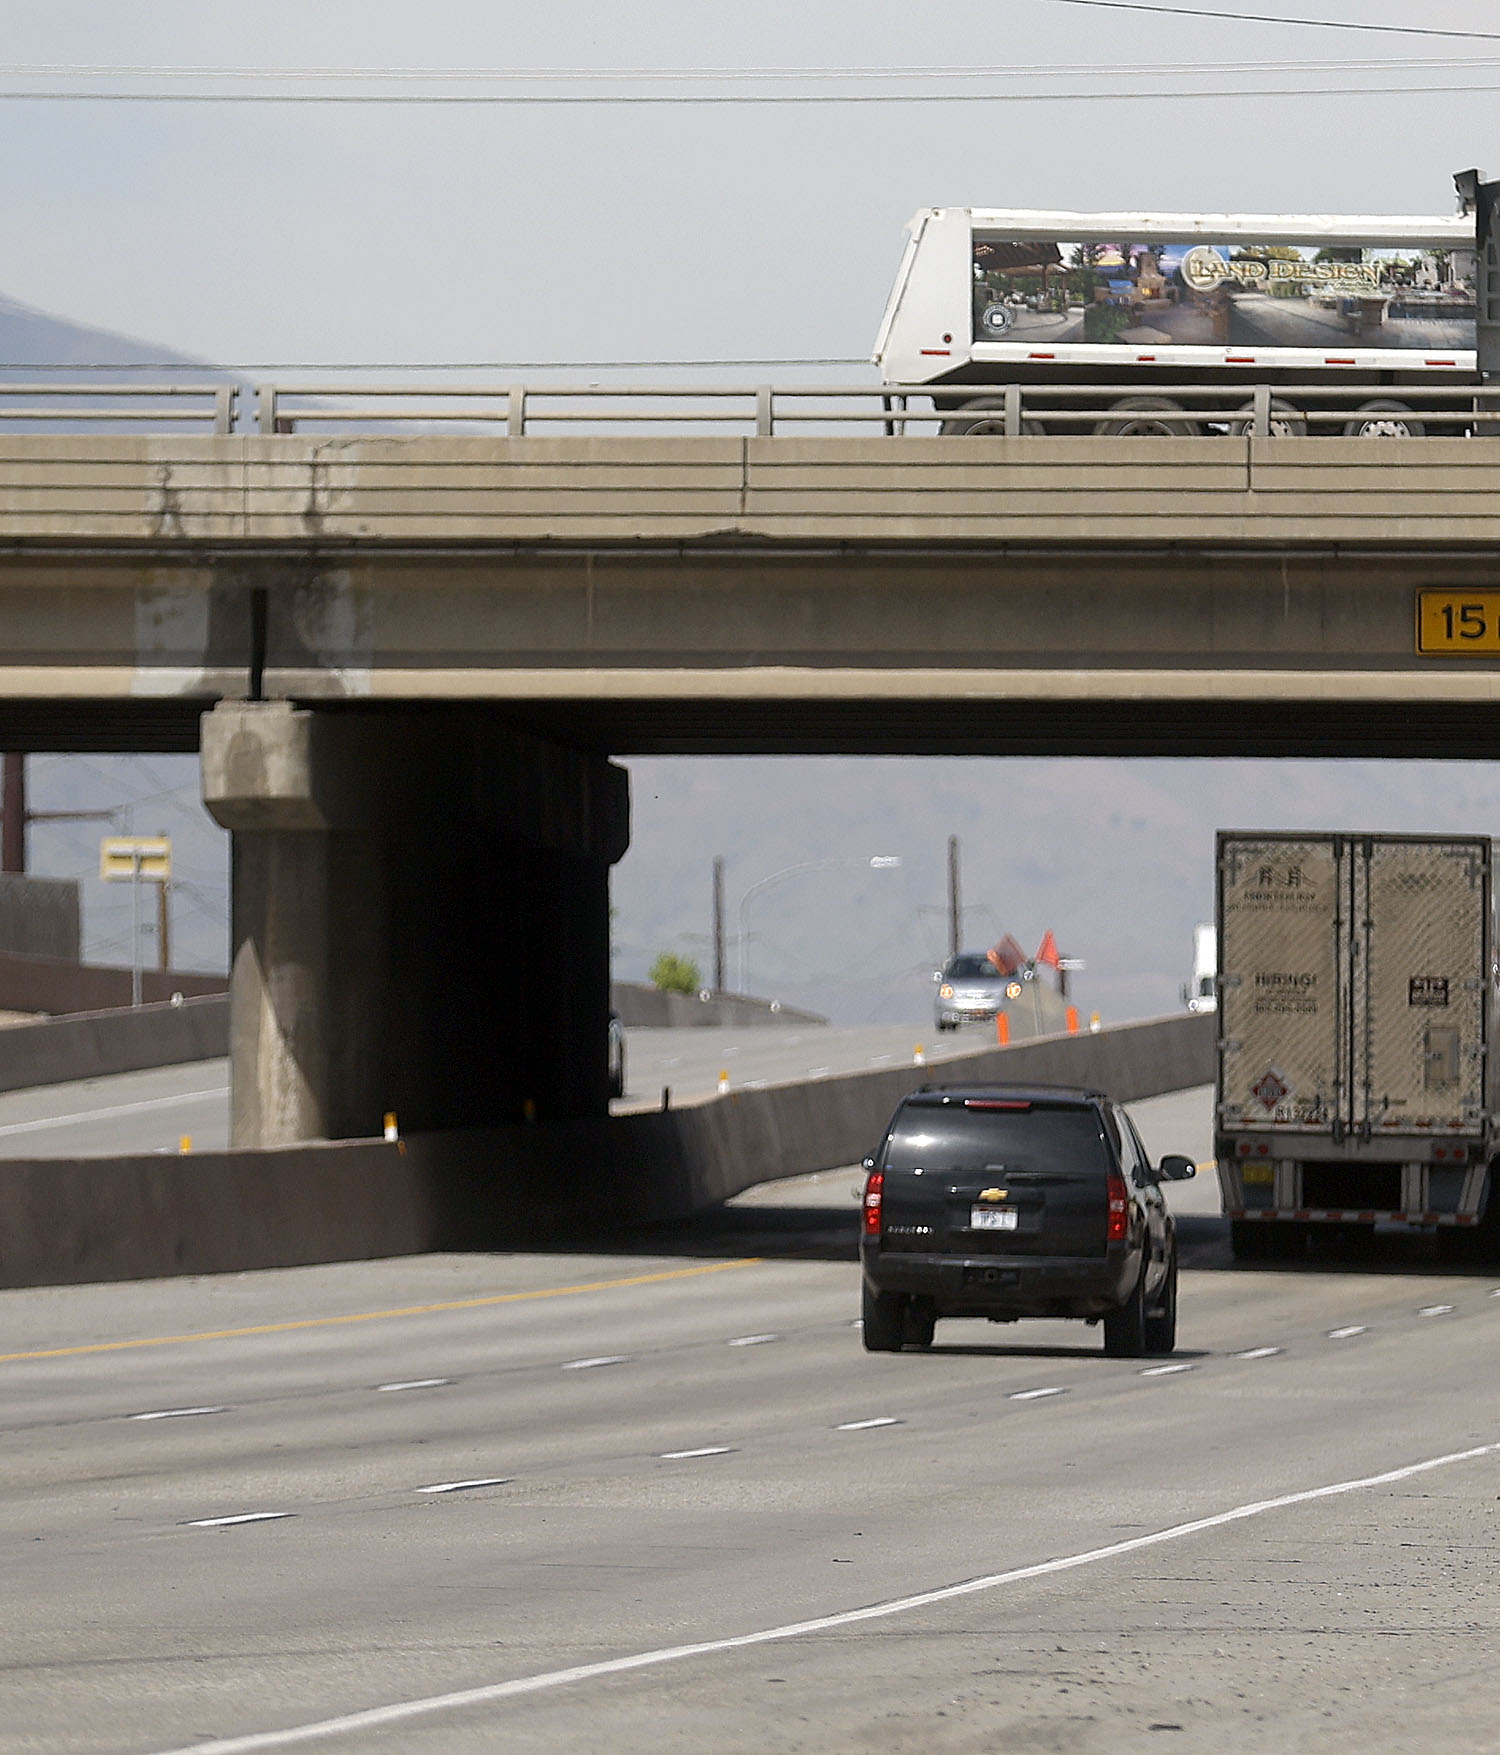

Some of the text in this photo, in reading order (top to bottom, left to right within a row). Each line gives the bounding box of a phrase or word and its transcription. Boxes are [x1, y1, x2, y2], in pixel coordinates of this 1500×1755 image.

[1190, 257, 1380, 284] LAND DESIGN
[1442, 604, 1487, 639] 15
